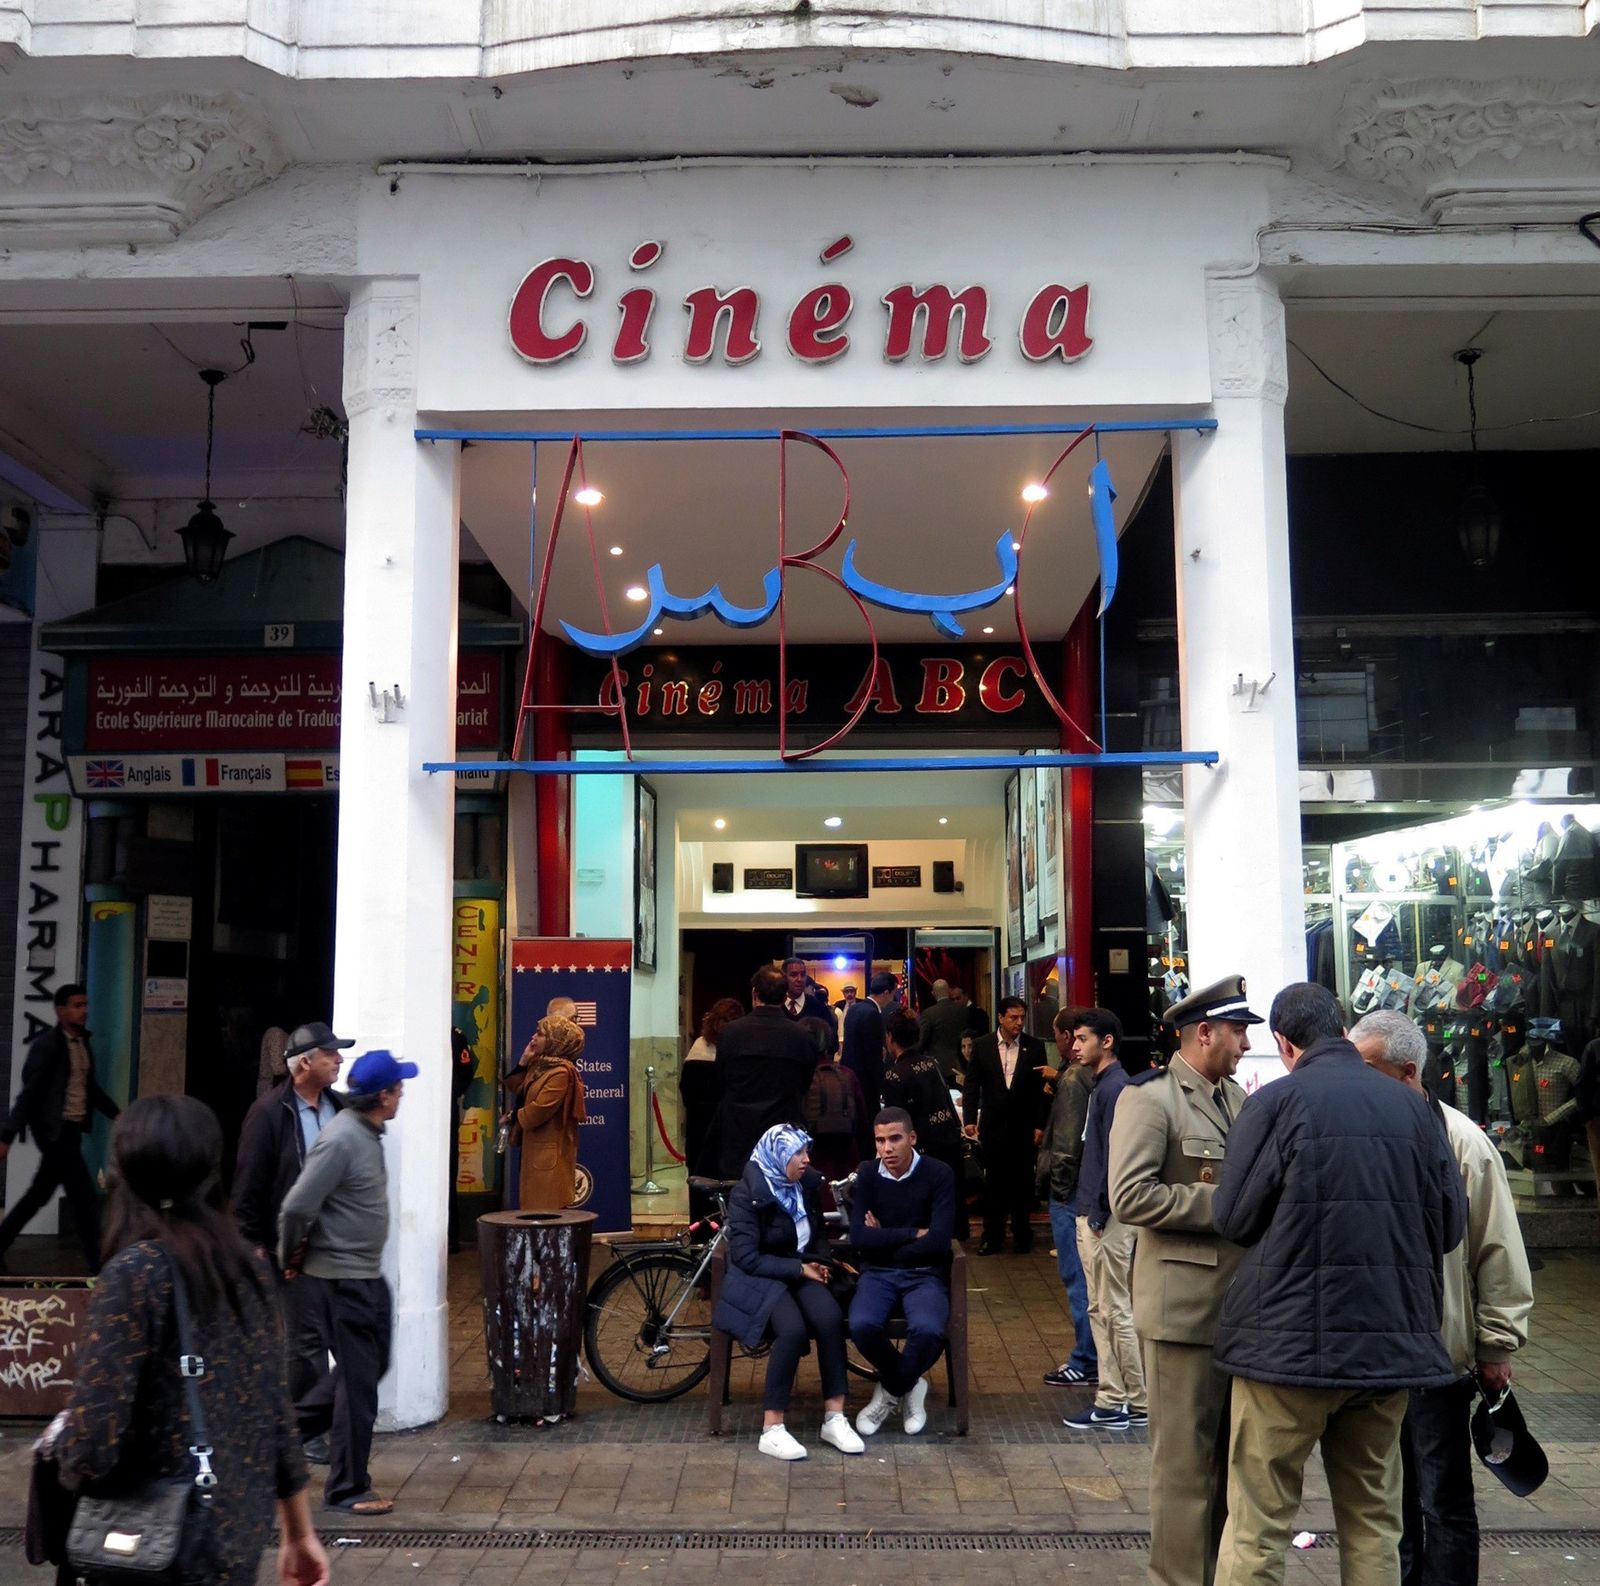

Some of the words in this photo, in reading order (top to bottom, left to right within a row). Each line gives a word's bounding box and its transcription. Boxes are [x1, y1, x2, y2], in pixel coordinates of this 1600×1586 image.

[507, 233, 1095, 365] Cinéma
[270, 626, 289, 641] 39
[96, 674, 153, 706] الفورية
[158, 673, 217, 704] الترجمة
[224, 683, 233, 704] و
[240, 672, 301, 704] للترجمة
[598, 658, 808, 716] Cinéma
[843, 656, 1029, 714] ABC
[132, 709, 202, 732] Supérieure
[206, 708, 275, 729] Marocaine
[277, 708, 293, 728] de
[127, 765, 171, 785] Anglais
[221, 764, 272, 784] Français
[575, 1058, 612, 1073] States
